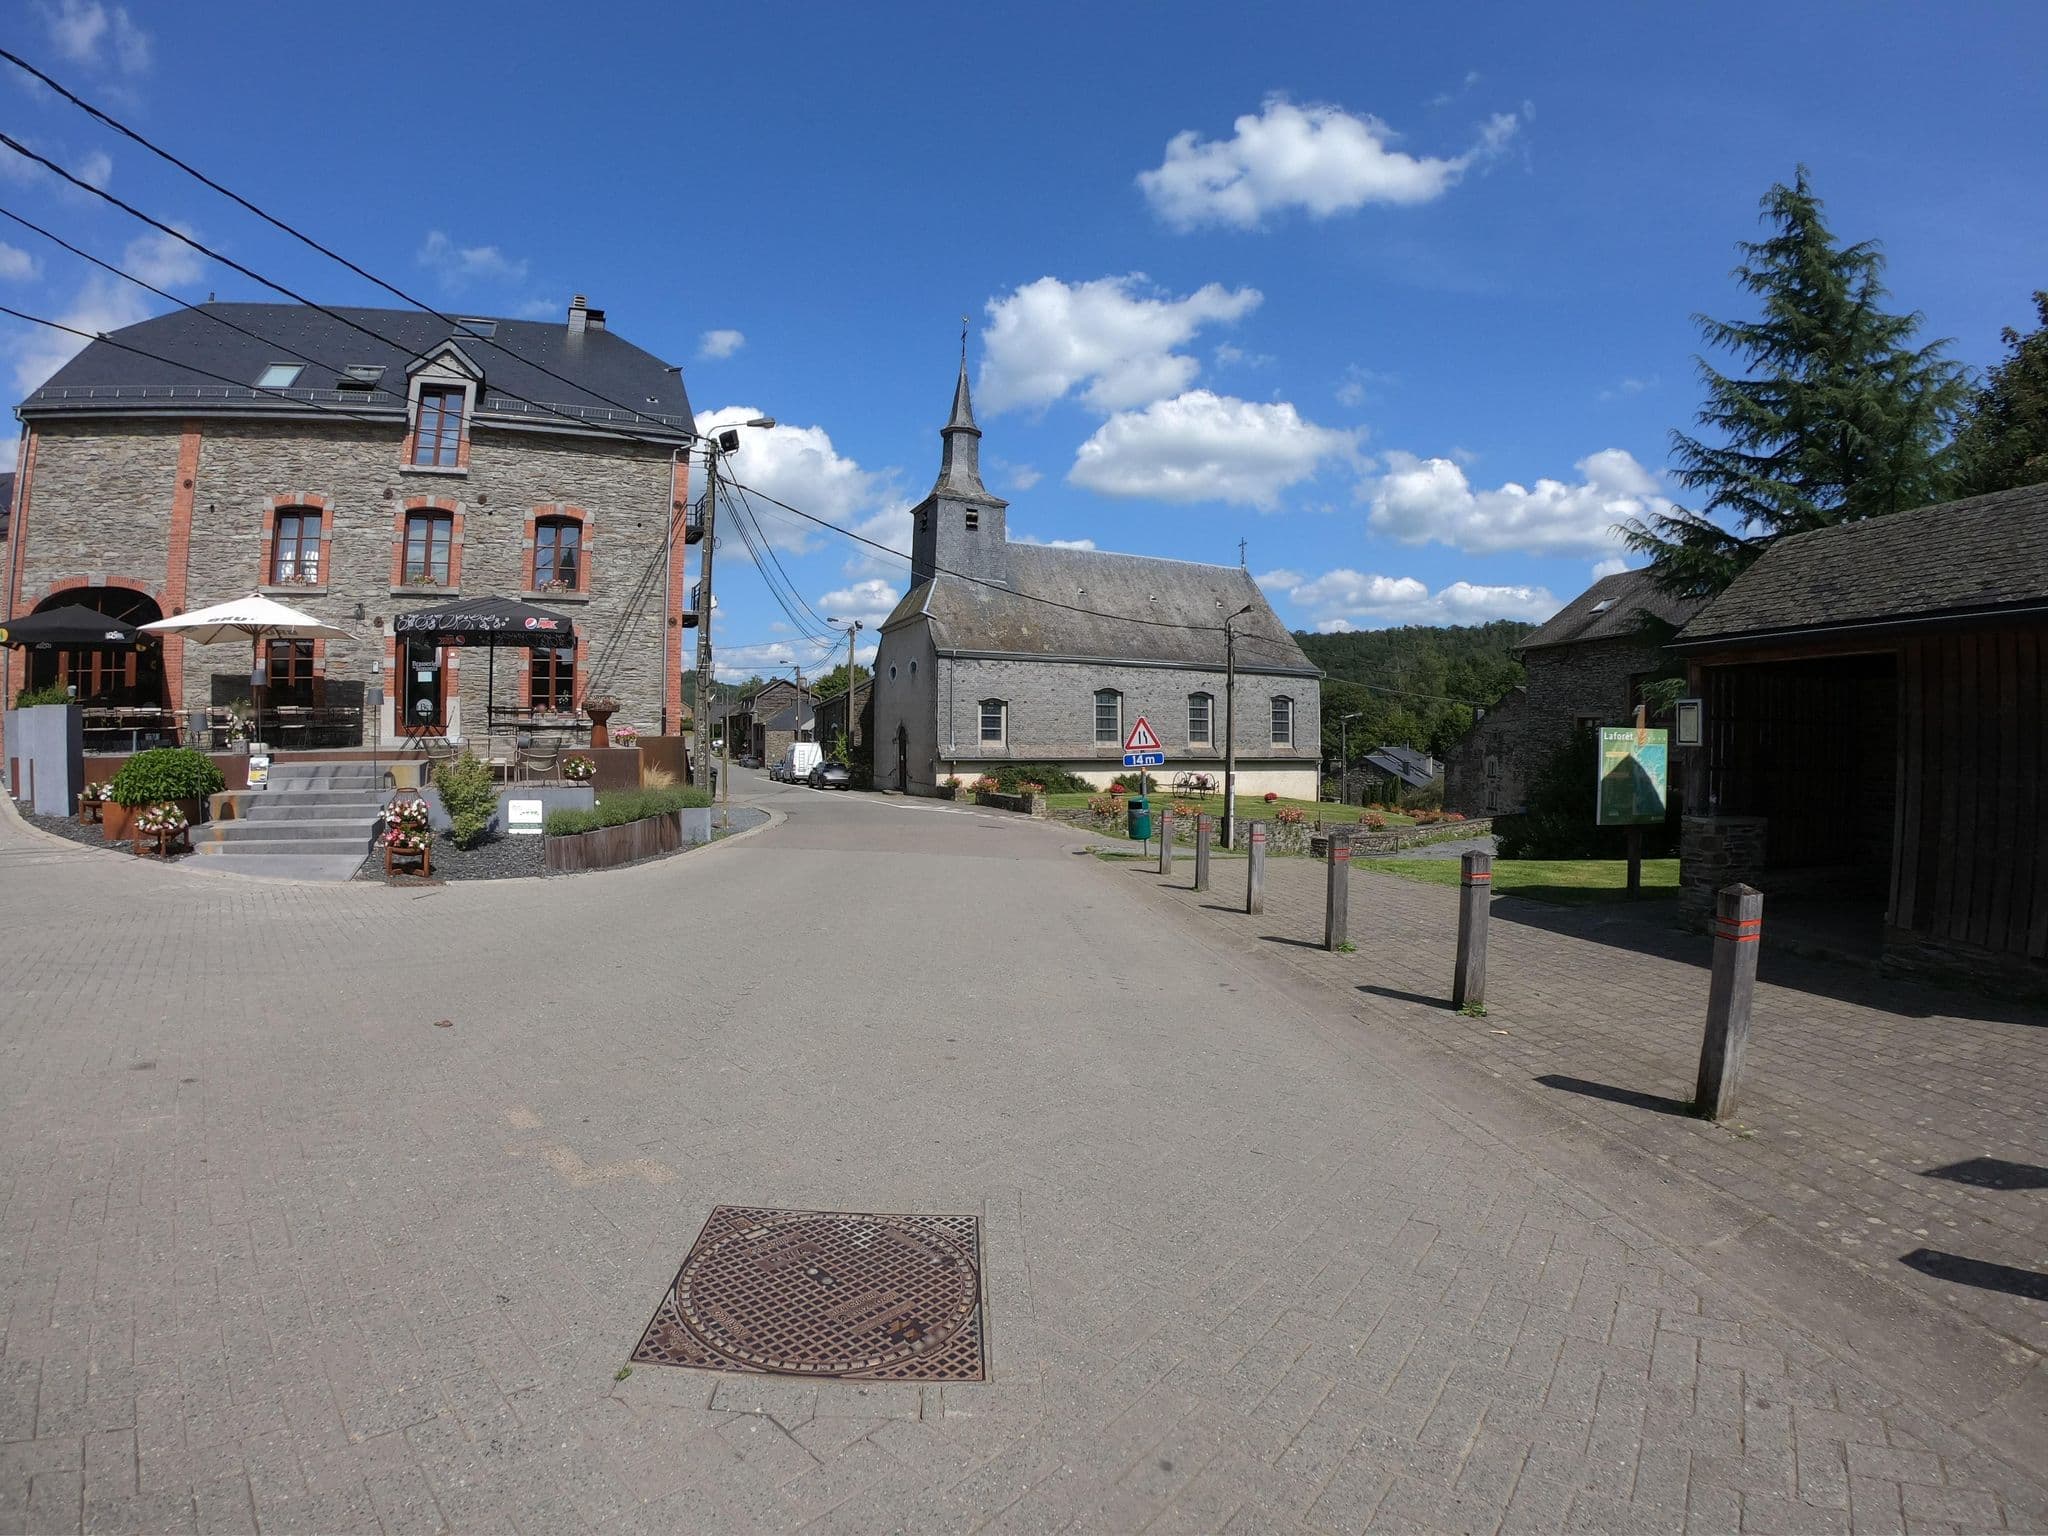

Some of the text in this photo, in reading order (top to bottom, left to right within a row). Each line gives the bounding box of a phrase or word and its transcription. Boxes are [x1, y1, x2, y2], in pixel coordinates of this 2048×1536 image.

[1603, 731, 1634, 741] Laforêt
[1132, 755, 1156, 765] 14 m
